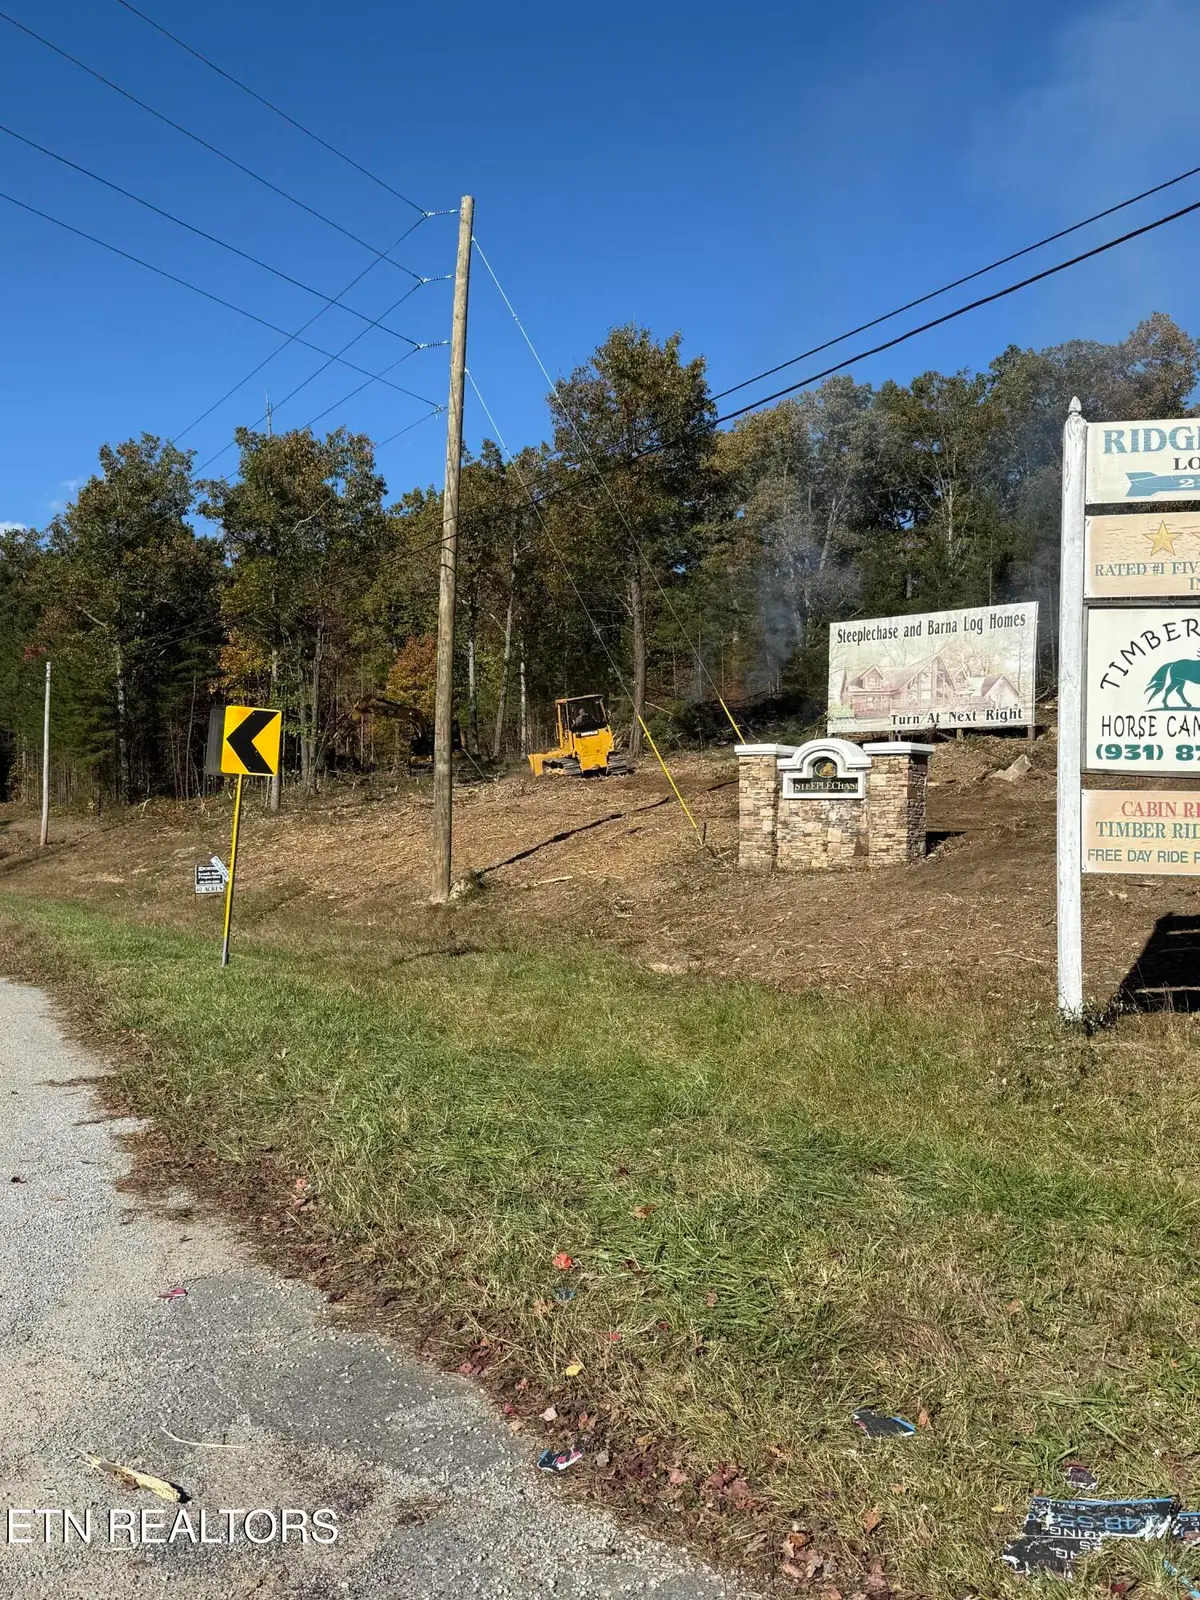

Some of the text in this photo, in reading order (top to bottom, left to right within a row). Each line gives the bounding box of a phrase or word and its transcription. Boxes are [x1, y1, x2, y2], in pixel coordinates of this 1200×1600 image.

[1102, 426, 1200, 455] RIDG
[1094, 562, 1147, 577] RATED
[1152, 562, 1165, 575] #1
[837, 613, 1026, 646] Steeplechase and Barna Log Homes
[1100, 618, 1200, 690] TIMBER
[890, 707, 1023, 725] Turn At Next Right
[1101, 714, 1158, 739] HORSE
[1095, 743, 1164, 762] (931)
[1121, 801, 1177, 817] CABIN
[1095, 821, 1166, 838] TIMBER
[1087, 848, 1122, 862] FREE
[1127, 849, 1153, 862] DAY
[1157, 850, 1189, 864] RIDE
